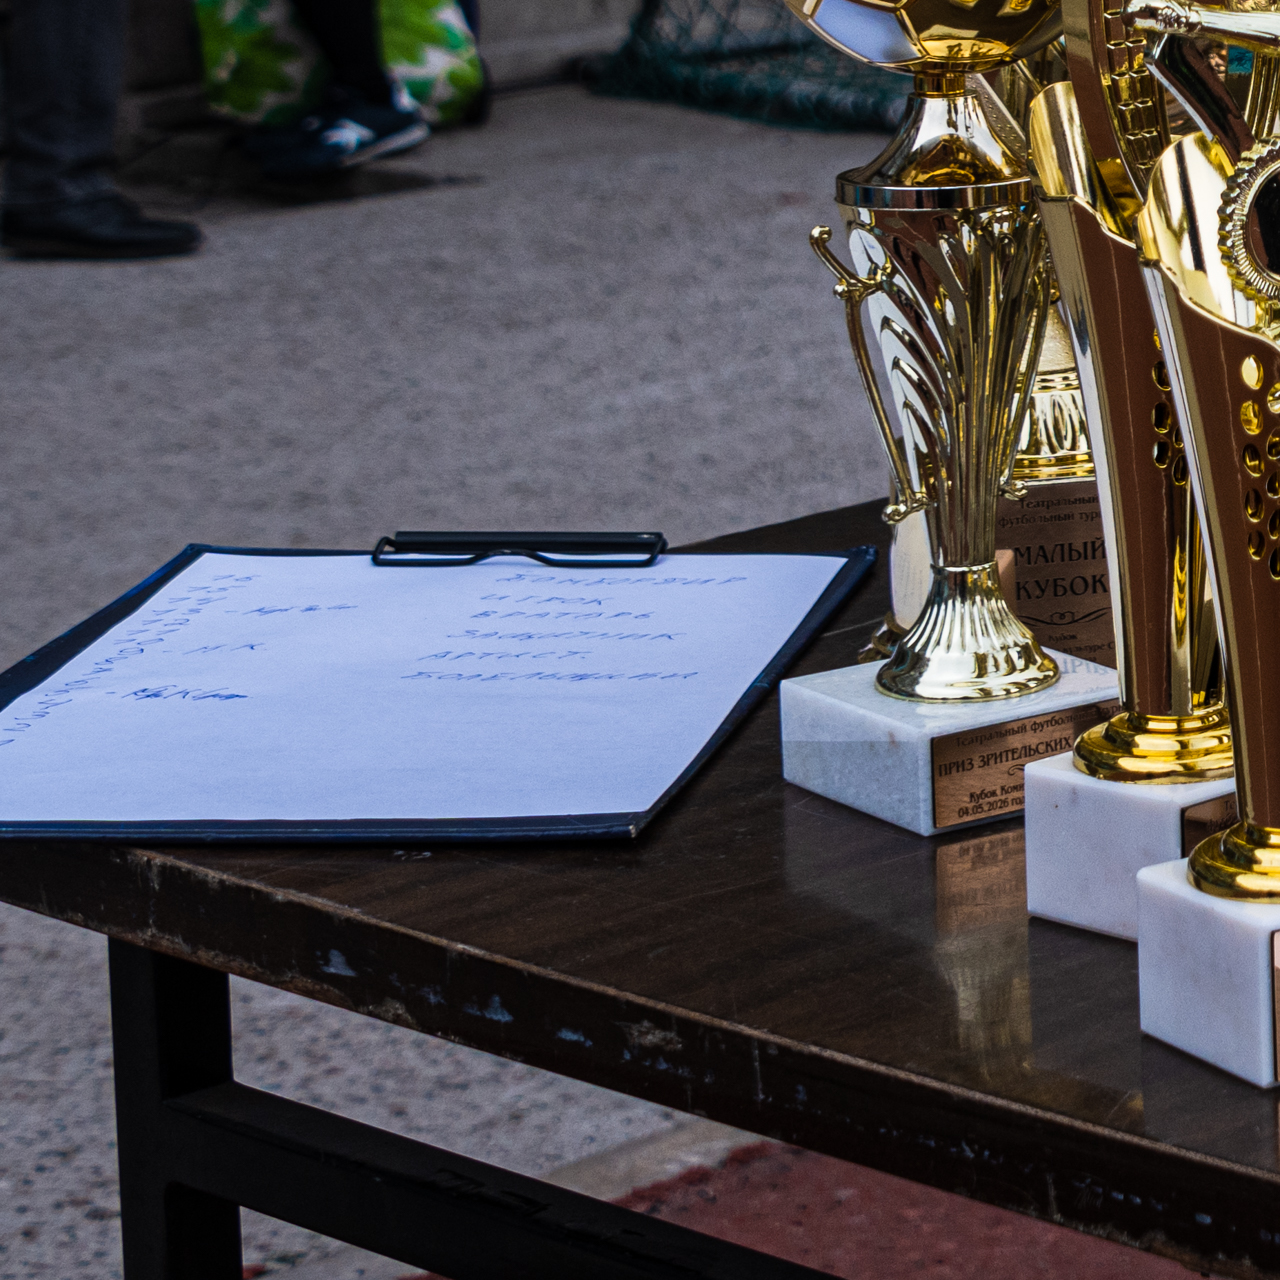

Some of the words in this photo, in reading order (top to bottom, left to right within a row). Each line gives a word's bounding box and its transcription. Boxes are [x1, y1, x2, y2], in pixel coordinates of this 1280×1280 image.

[1014, 537, 1106, 566] МАЛЫЙ
[1016, 574, 1108, 601] КУБОК
[479, 594, 613, 606] ИГРОК
[447, 629, 688, 641] ЗАЩИТНИК
[400, 671, 699, 681] БОЛЕЛЬЩИКИ
[954, 723, 1027, 747] Театральный
[938, 759, 974, 777] ПРИЗ
[978, 736, 1072, 768] ЗРИТЕЛЬСКИХ
[969, 788, 998, 804] Кубок
[958, 799, 1009, 818] 04.05.2026
